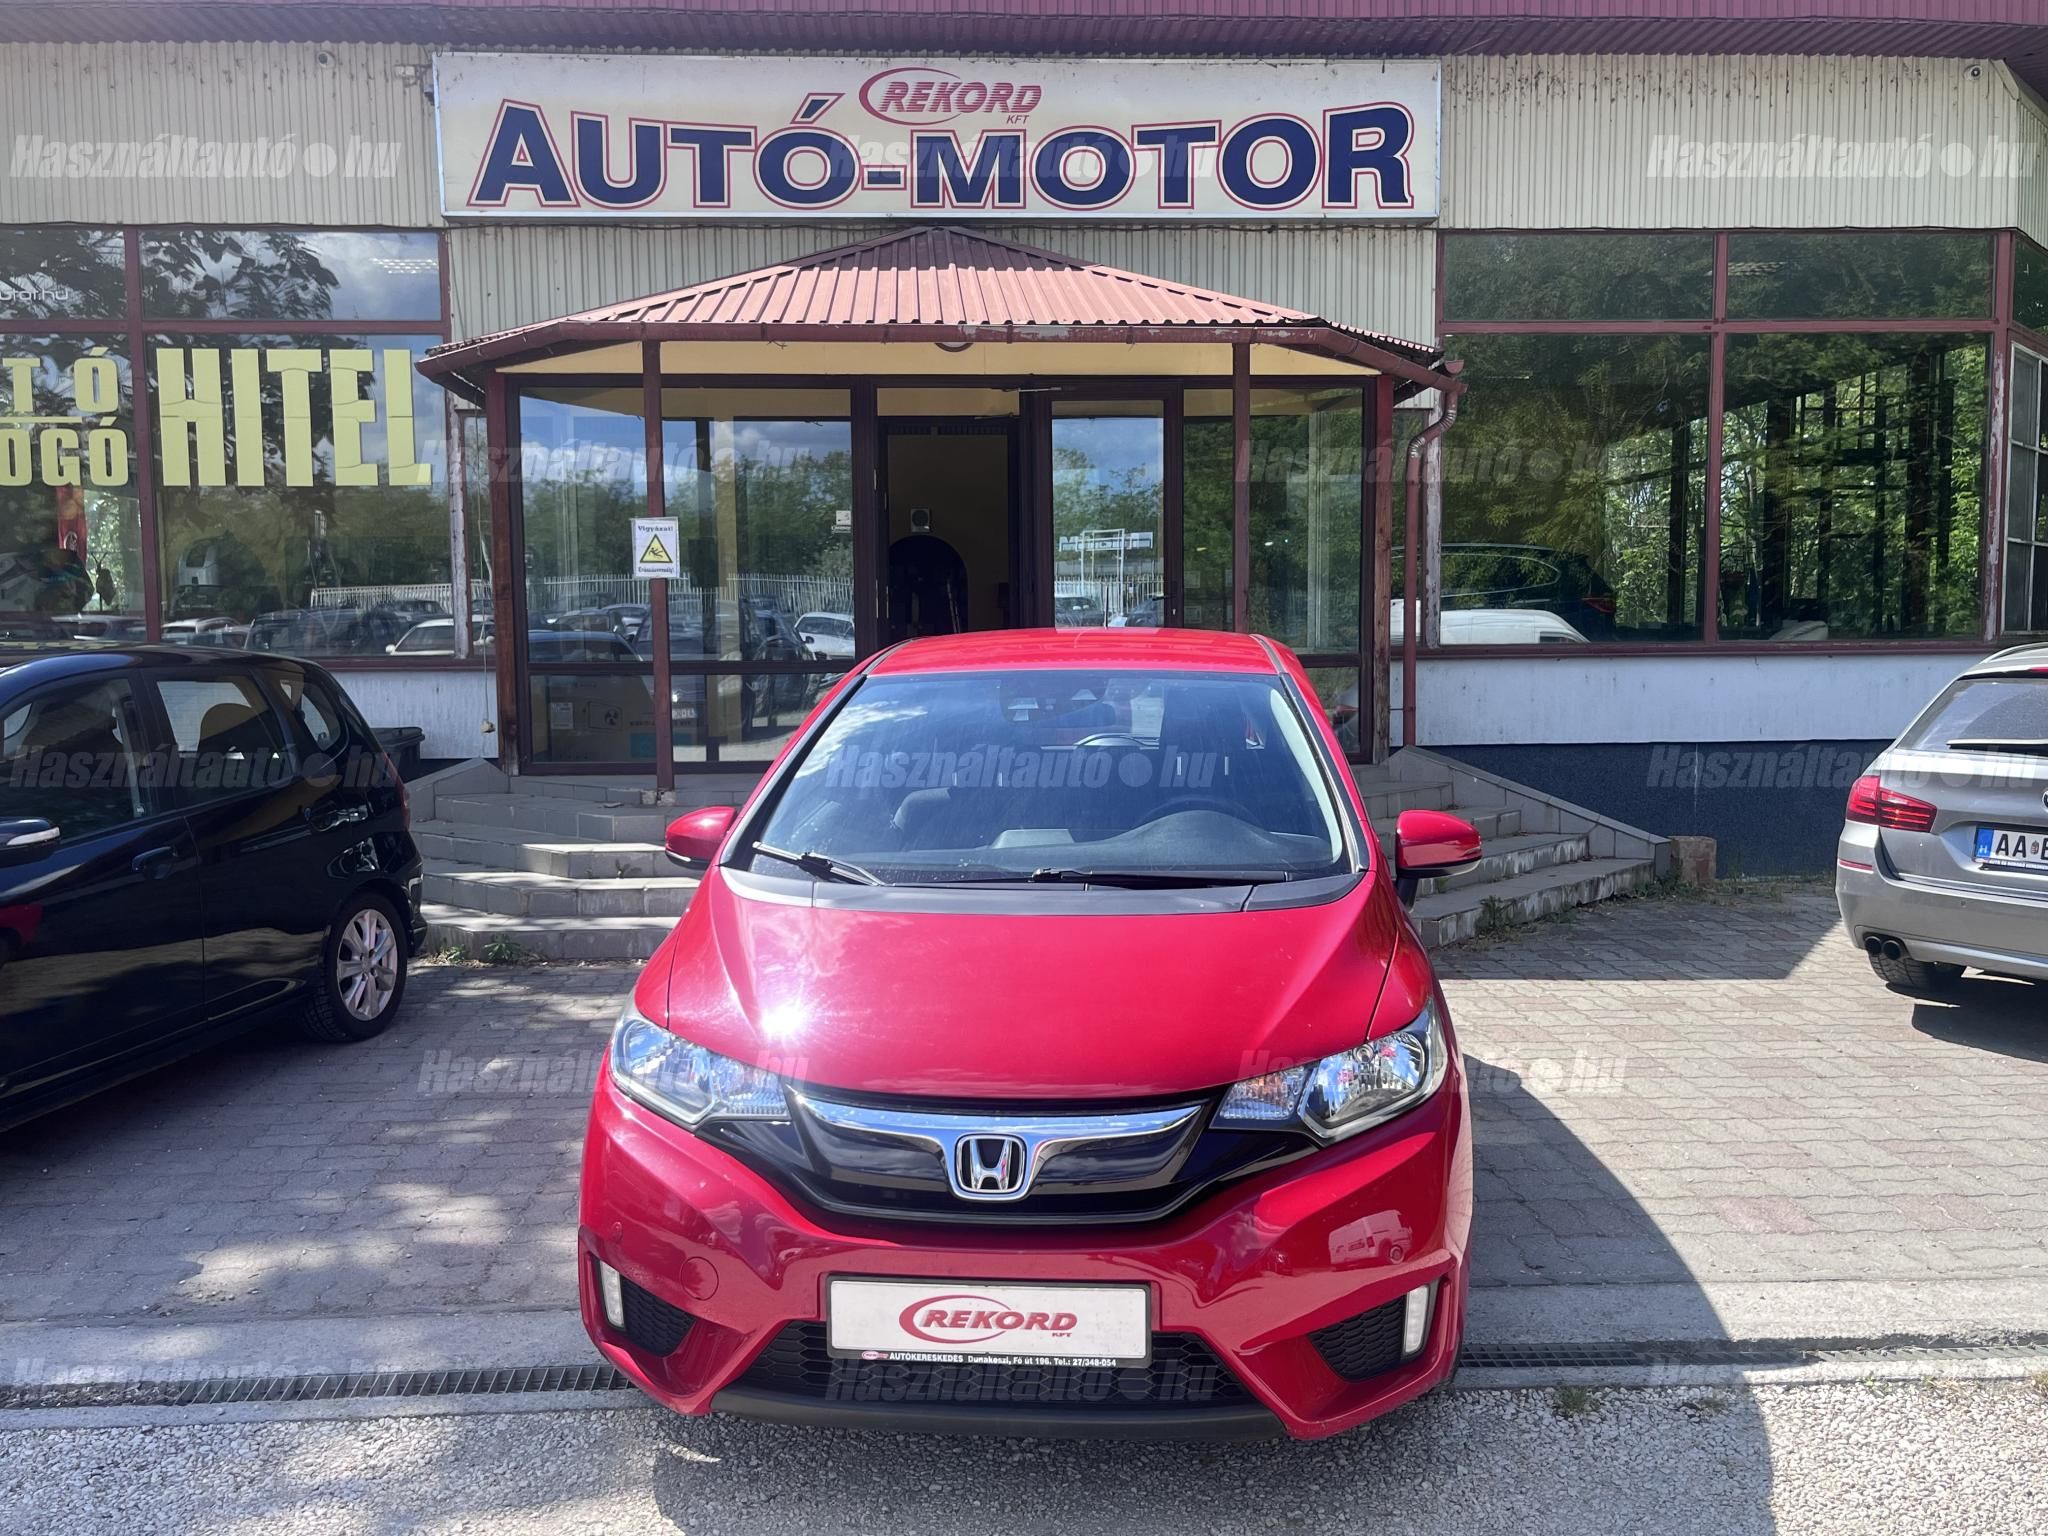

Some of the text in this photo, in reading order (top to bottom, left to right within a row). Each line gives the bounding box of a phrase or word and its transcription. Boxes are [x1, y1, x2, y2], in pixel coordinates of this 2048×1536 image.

[879, 81, 1042, 113] REKORD
[1006, 114, 1029, 124] KFT
[466, 92, 1415, 209] AUTÓ-MOTOR
[156, 348, 432, 486] HITEL
[921, 1309, 1078, 1331] REKORD
[967, 1355, 1011, 1366] Dunakeszi,
[1024, 1356, 1033, 1365] út
[1054, 1357, 1071, 1366] Tel.:
[1072, 1358, 1117, 1368] 27/348-054
